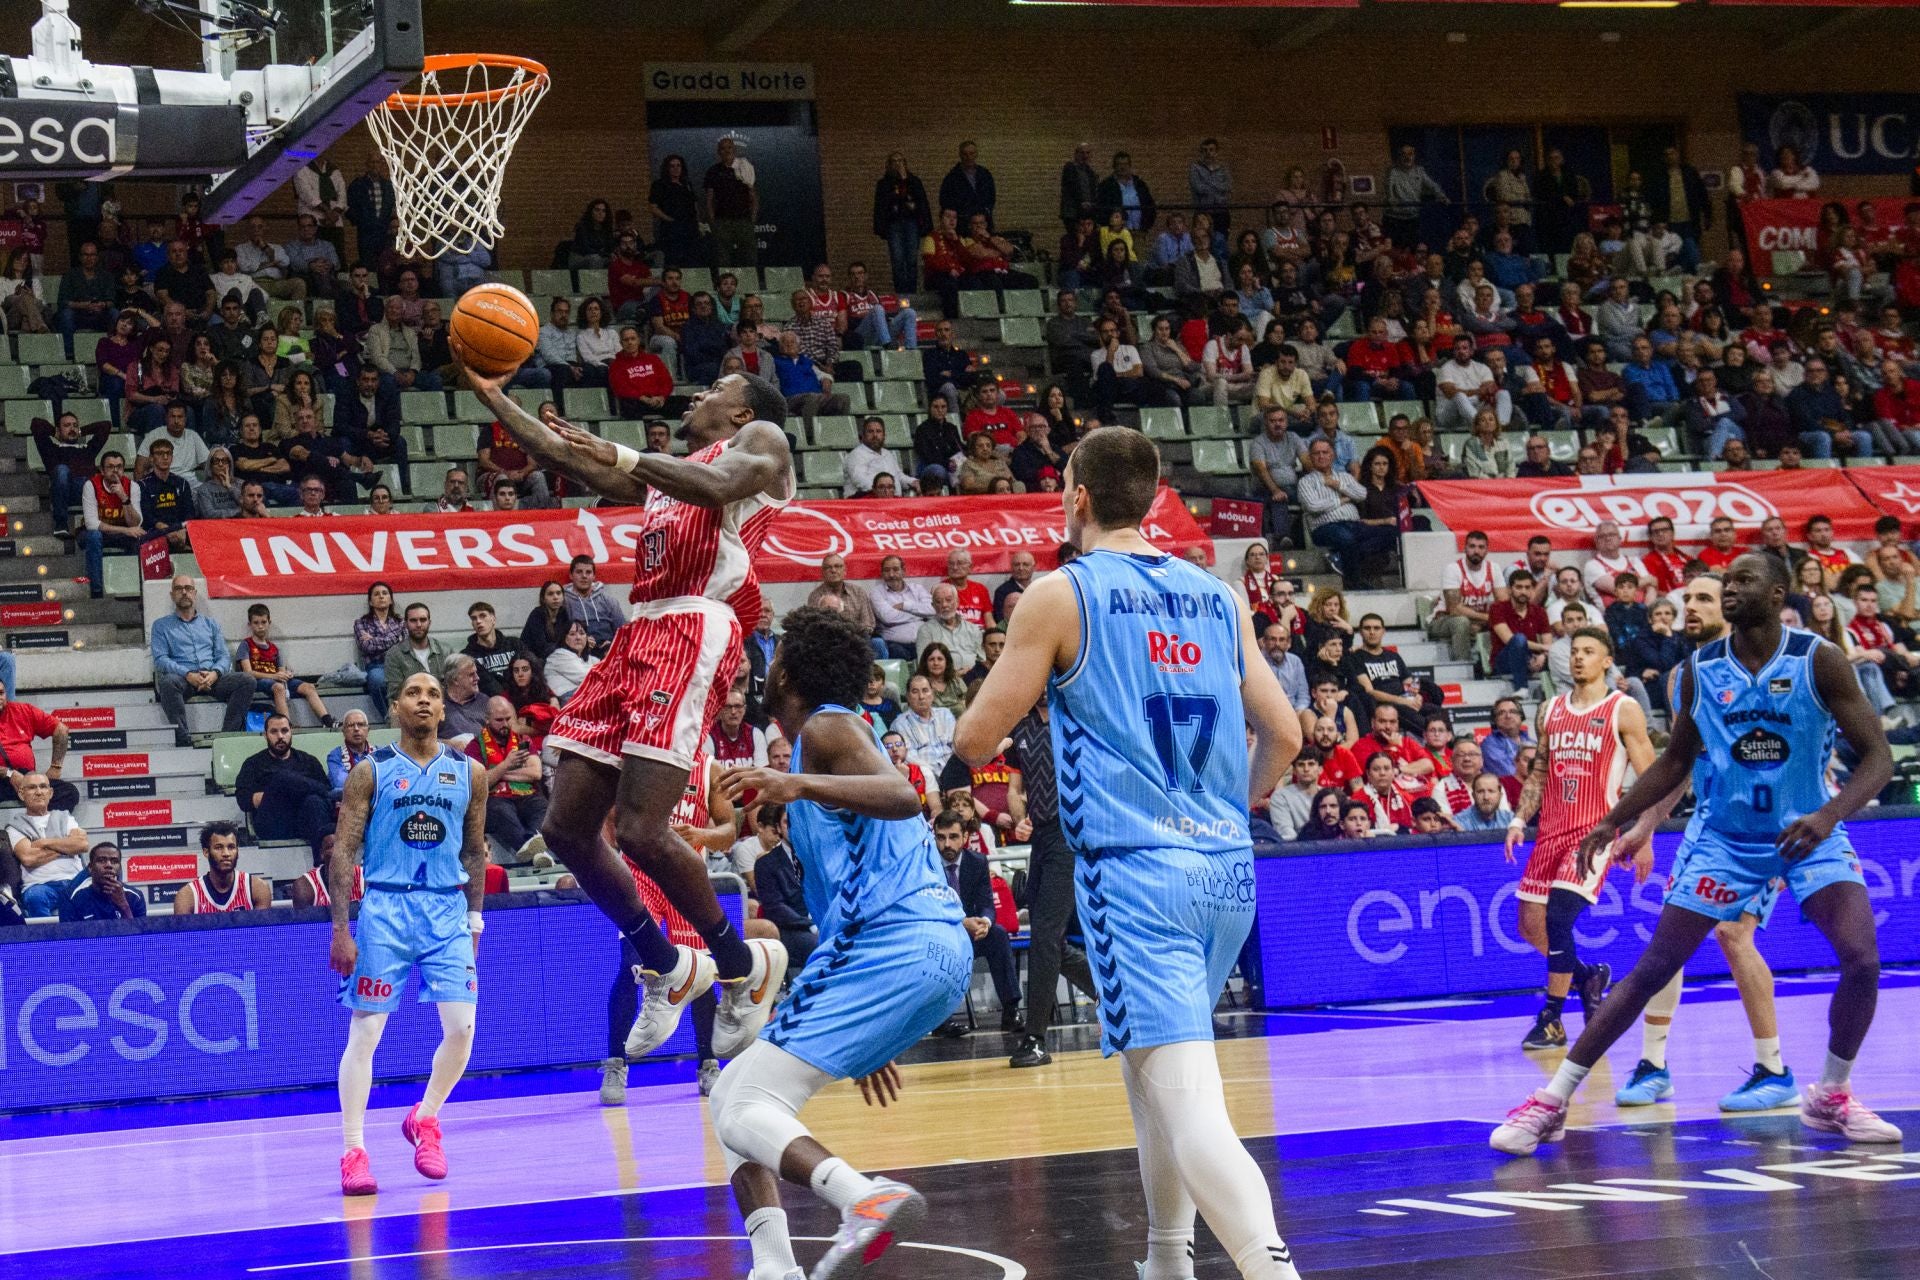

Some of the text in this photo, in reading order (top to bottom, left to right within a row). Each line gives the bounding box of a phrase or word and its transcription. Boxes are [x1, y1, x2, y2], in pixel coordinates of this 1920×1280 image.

[652, 70, 806, 90] Grada Norte
[1828, 112, 1920, 159] UC
[865, 513, 961, 532] Costa Cálida
[1218, 511, 1255, 523] MÓDULO
[872, 526, 995, 550] REGIÓN
[1000, 526, 1043, 546] DE
[1365, 660, 1399, 679] EVERLAST
[1142, 692, 1220, 793] 17
[1549, 731, 1603, 753] UCAM
[1740, 740, 1782, 751] Estrella
[1555, 750, 1592, 762] MURCIA
[1742, 750, 1780, 761] Galicia
[1563, 779, 1578, 802] 12
[1752, 784, 1773, 812] 0
[407, 821, 438, 831] Estrella
[408, 831, 437, 840] Galicia
